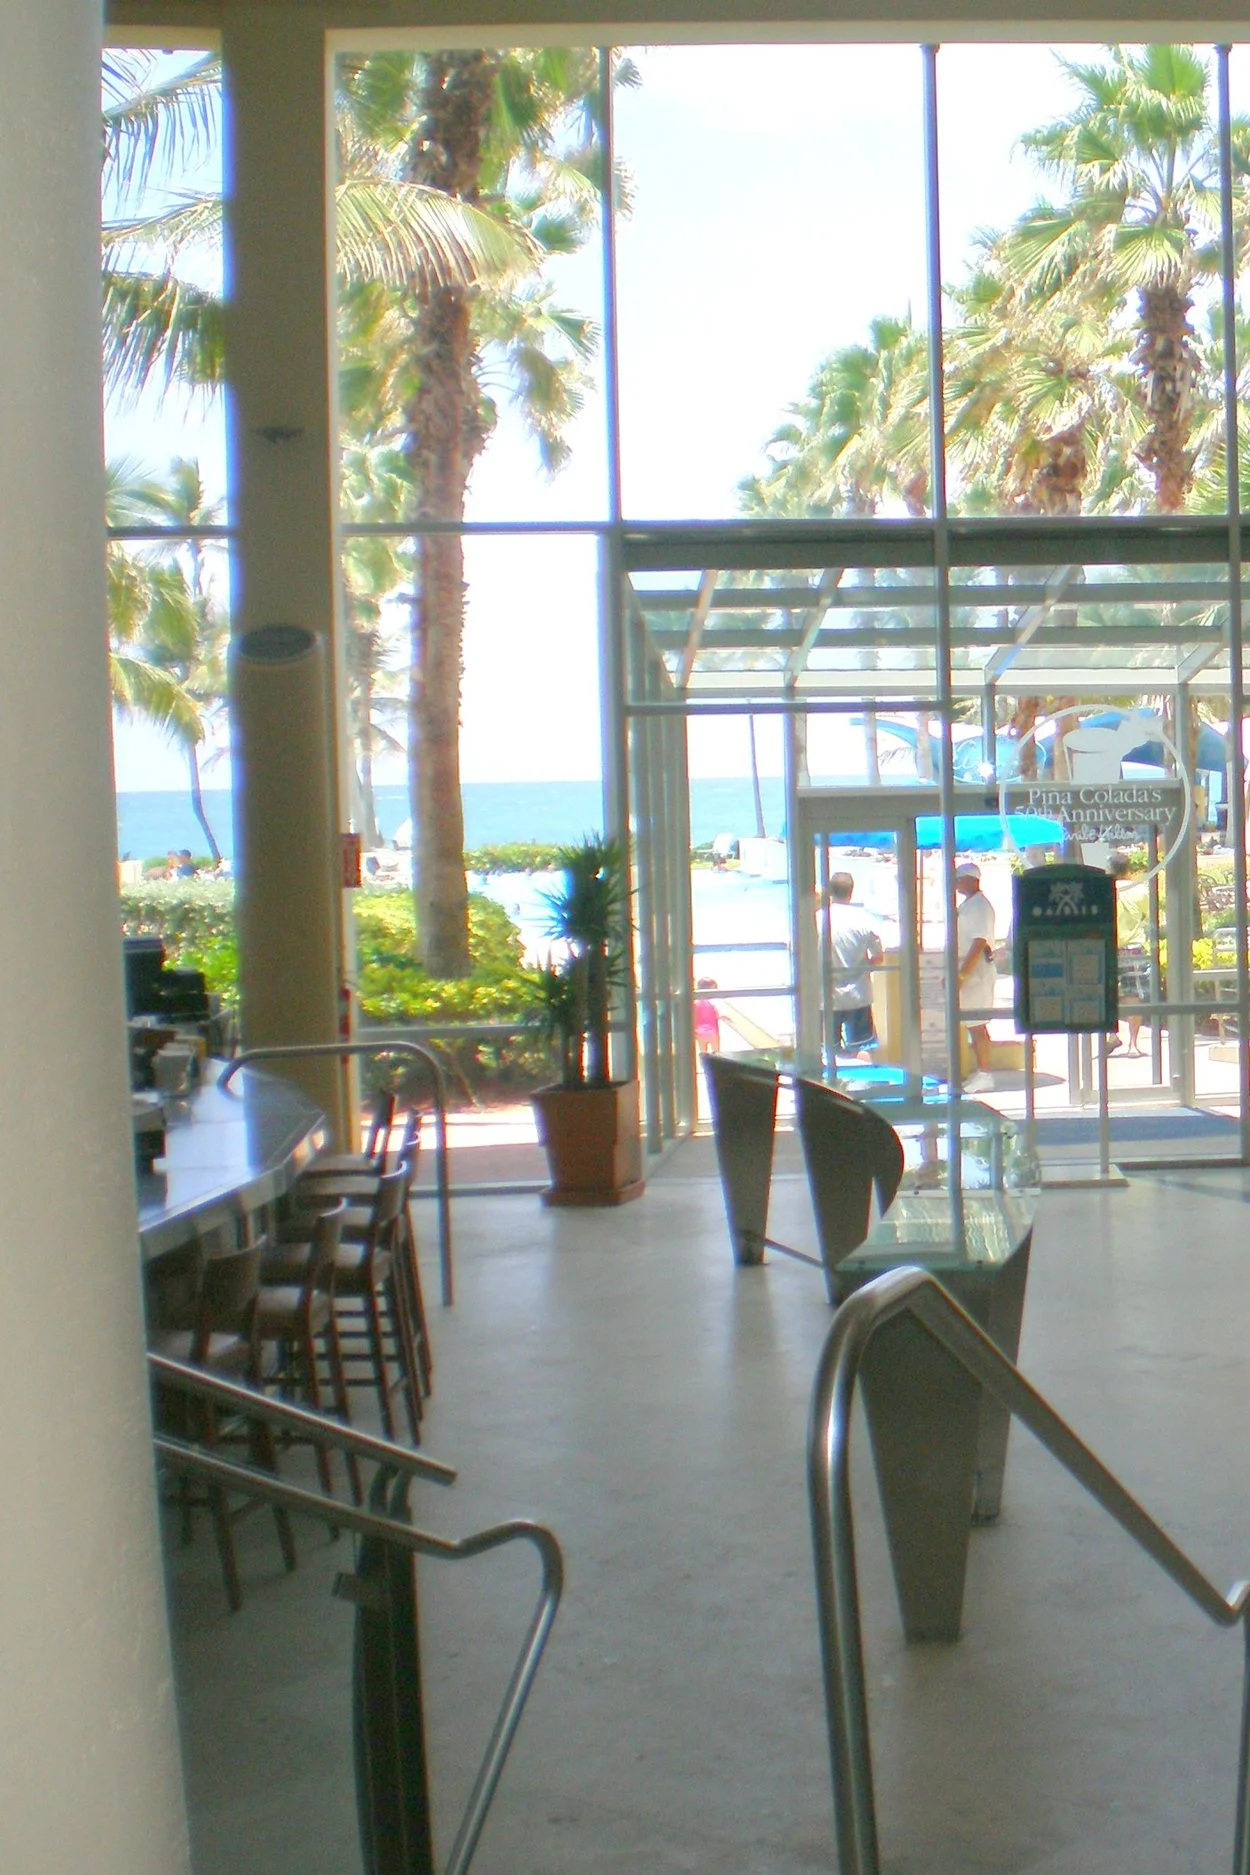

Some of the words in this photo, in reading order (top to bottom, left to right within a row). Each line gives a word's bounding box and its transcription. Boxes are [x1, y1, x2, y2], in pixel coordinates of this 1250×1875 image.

[1028, 787, 1072, 805] Piña
[1079, 785, 1162, 804] Colada's
[1057, 804, 1176, 825] Anniversary
